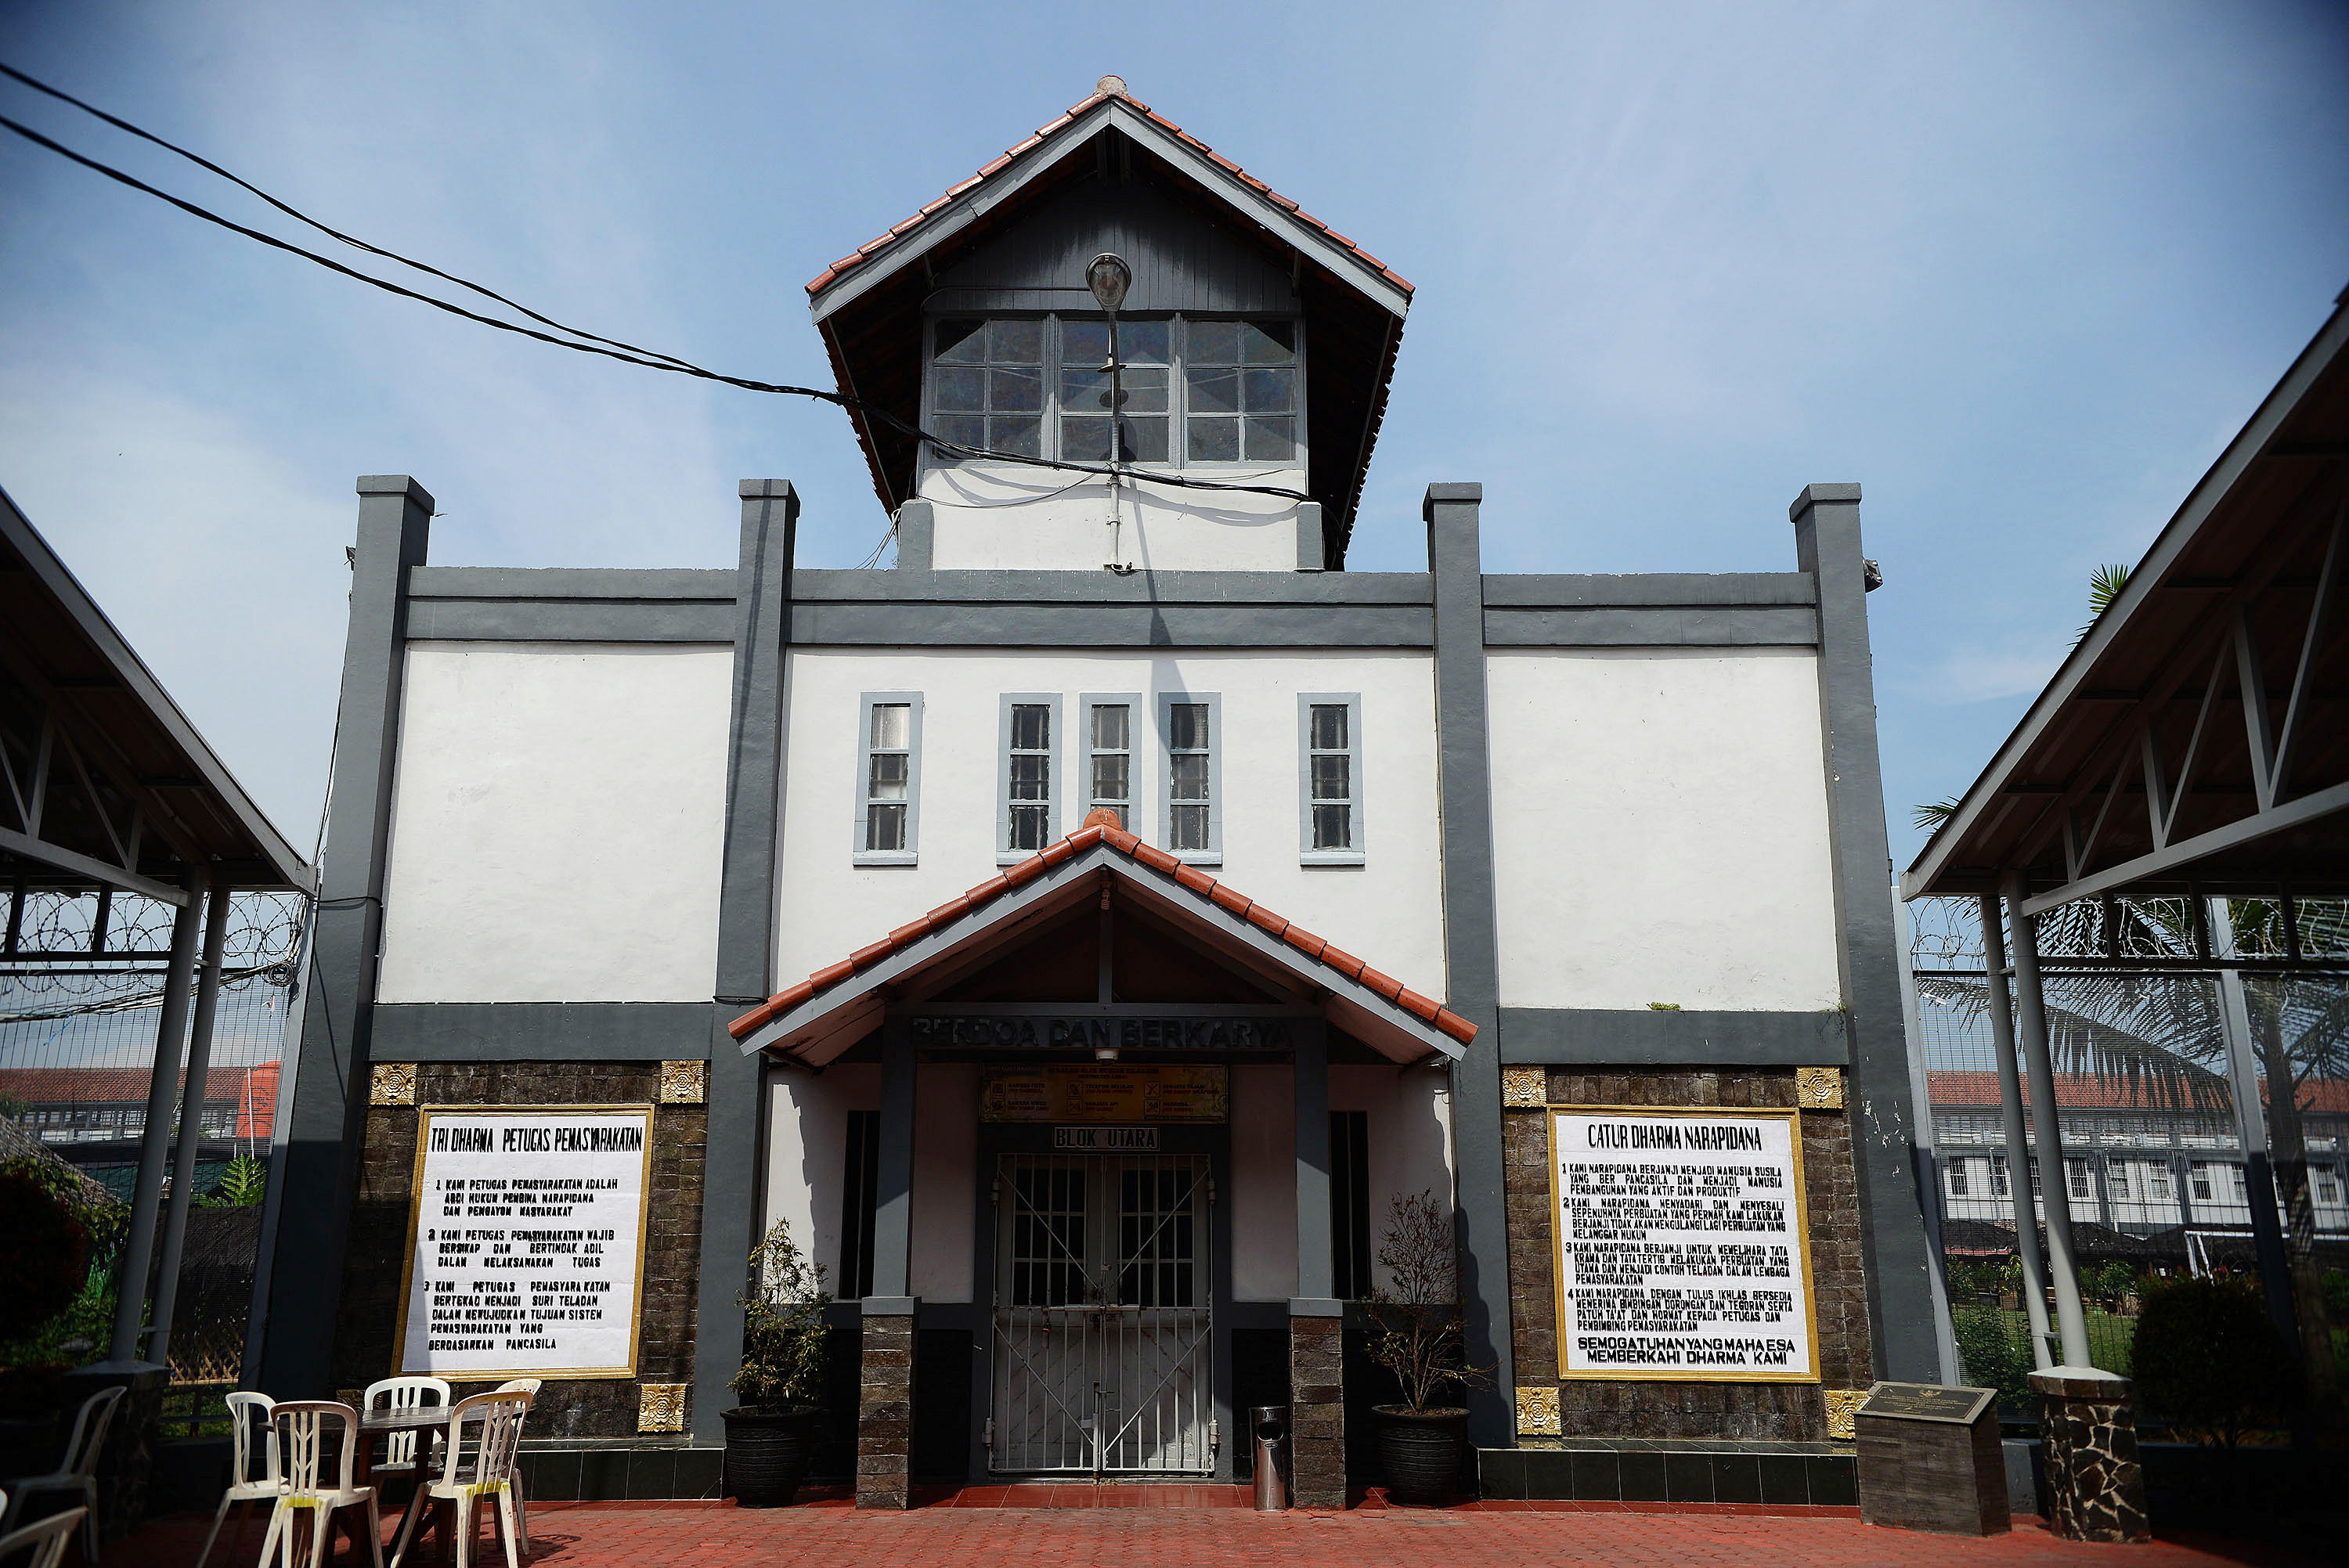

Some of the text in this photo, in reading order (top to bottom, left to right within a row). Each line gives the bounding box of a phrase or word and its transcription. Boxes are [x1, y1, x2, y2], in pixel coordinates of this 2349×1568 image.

[431, 1127, 642, 1152] TRI DHARMA PETUGAS PEMASYARAKATAN
[1056, 1129, 1155, 1147] BLOK UTARA
[1588, 1124, 1762, 1151] CATUR DHARMA NARAPIDANA
[1562, 1163, 1782, 1177] 1 KAMI NARAPIDANA BERJANJI MENJADI MANUSIA SUSILA
[436, 1179, 618, 1191] 1 KAMI PETUGAS PEMASYARAKATAN ADALAH
[1570, 1174, 1782, 1188] YANG BER PANCASILA DAN MENJADI MANUSIA
[1571, 1184, 1741, 1198] PEMBANGUNAN YANG AKTIF DAN PRODUKTIF
[445, 1193, 594, 1204] ABDI HUKUM PEMBINA NARAPIDANA
[1564, 1198, 1569, 1209] 2
[1571, 1199, 1589, 1207] KAMI
[1601, 1199, 1650, 1208] NARAPIDANA
[1660, 1199, 1702, 1209] MENYADARI
[1713, 1200, 1728, 1209] DAN
[443, 1206, 460, 1216] DAN
[519, 1206, 572, 1217] MASYARAKAT
[1572, 1209, 1783, 1221] SEPENUHNYA PERBUATAN YANG PERNAH KAMI LAKUKAN
[1572, 1218, 1785, 1232] BERJANJI TIDAK AKAN MENGULANGI LAGI PERBUATAN YANG
[428, 1229, 614, 1242] 2 KAMI PETUGAS PEMASYARAKATAN WAJIB
[1573, 1229, 1646, 1240] MELANGGAR HUKUM
[439, 1243, 604, 1253] BERSIKAP DAN BERTINDAK ADIL
[1566, 1242, 1788, 1256] 3 KAMI NARAPIDANA BERJANJI UNTUK MEMELIHARA TATA
[438, 1257, 601, 1267] DALAM MELAKSANAKAN TUGAS
[1575, 1253, 1600, 1263] KRAMA
[1603, 1253, 1618, 1263] DAN
[1670, 1255, 1716, 1265] MELAKUKAN
[1721, 1255, 1765, 1266] PERBUATAN
[1770, 1256, 1789, 1267] YANG
[1575, 1263, 1790, 1278] UTAMA DAN MENJADI CONTOH TELADAN DALAM LEMBAGA
[1575, 1274, 1643, 1285] PEMASYARAKATAN
[424, 1281, 430, 1291] 3
[435, 1281, 455, 1292] KAMI
[473, 1281, 515, 1292] PETUGAS
[434, 1296, 598, 1307] BERTEKAD MENJADI SURI TELADAN
[1568, 1289, 1792, 1302] 4 KAMI NARAPIDANA DENGAN TULUS IKHLAS BERSEDIA
[1576, 1299, 1616, 1309] MENERIMA
[1620, 1299, 1661, 1309] BIMBINGAN
[1710, 1300, 1726, 1310] DAN
[1768, 1301, 1792, 1312] SERTA
[432, 1309, 602, 1320] DALAM MEWUJUDKAN TUJUAN SISTEM
[1577, 1310, 1603, 1320] PATUH
[1631, 1310, 1647, 1320] DAN
[1653, 1310, 1683, 1321] HORMAT
[1687, 1311, 1717, 1321] KEPADA
[1723, 1311, 1760, 1322] PETUGAS
[1766, 1312, 1781, 1322] DAN
[431, 1324, 543, 1334] PEMASYARAKATAN YANG
[1578, 1321, 1698, 1332] PEMBIMBING PEMASYARAKATAN
[428, 1339, 556, 1350] BERDASARKAN PANCASILA
[1687, 1339, 1722, 1350] YANG
[1725, 1339, 1763, 1350] MAHA
[1766, 1339, 1795, 1353] ESA
[1588, 1350, 1787, 1364] MEMBERKAHI DHARMA KAMI
